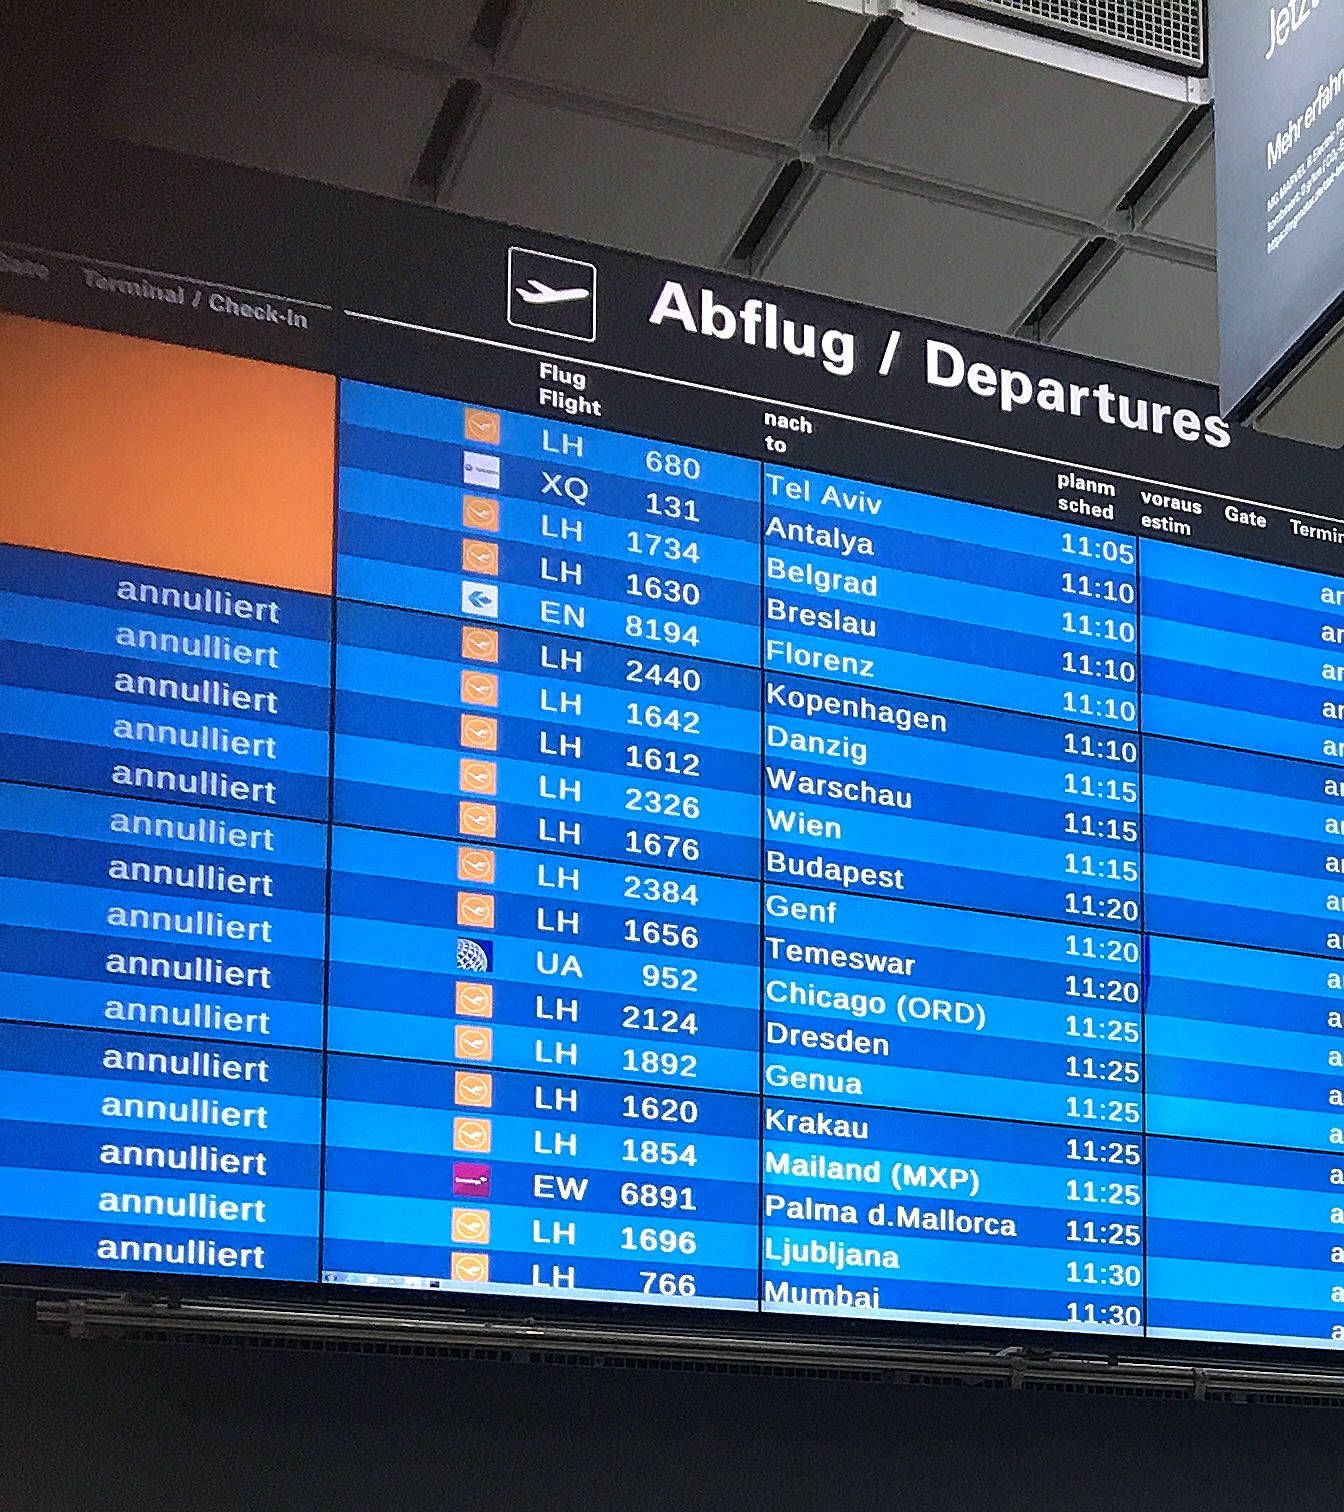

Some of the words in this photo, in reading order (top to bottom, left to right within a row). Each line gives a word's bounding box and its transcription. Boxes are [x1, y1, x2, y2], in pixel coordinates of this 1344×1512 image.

[1266, 116, 1304, 169] Mehr
[208, 293, 309, 329] Check-In
[540, 362, 585, 390] Flug
[652, 281, 853, 375] Abflug
[879, 331, 900, 375] /
[926, 339, 1231, 447] Departures
[540, 388, 601, 416] Flight
[765, 413, 812, 433] nach
[765, 436, 786, 452] to
[543, 430, 582, 457] LH
[646, 451, 700, 479] 680
[766, 473, 809, 501] Tel
[821, 486, 881, 514] Aviv
[1063, 534, 1134, 564] 11:05
[1058, 473, 1115, 496] planm
[1141, 492, 1202, 514] voraus
[1225, 506, 1266, 527] Gate
[1059, 499, 1113, 520] sched
[1142, 516, 1190, 535] estim
[118, 582, 280, 623] annulliert
[537, 951, 582, 977] UA
[643, 965, 697, 991] 952
[767, 981, 886, 1017] Chicago
[897, 995, 985, 1030] (ORD)
[1067, 1016, 1139, 1042] 11:25
[102, 1097, 267, 1128] annulliert
[535, 1175, 588, 1200] EW
[621, 1183, 696, 1210] 6891
[766, 1195, 858, 1223] Palma
[869, 1204, 1017, 1236] d.Mallorca
[1067, 1221, 1140, 1246] 11:25
[97, 1240, 264, 1268] annulliert
